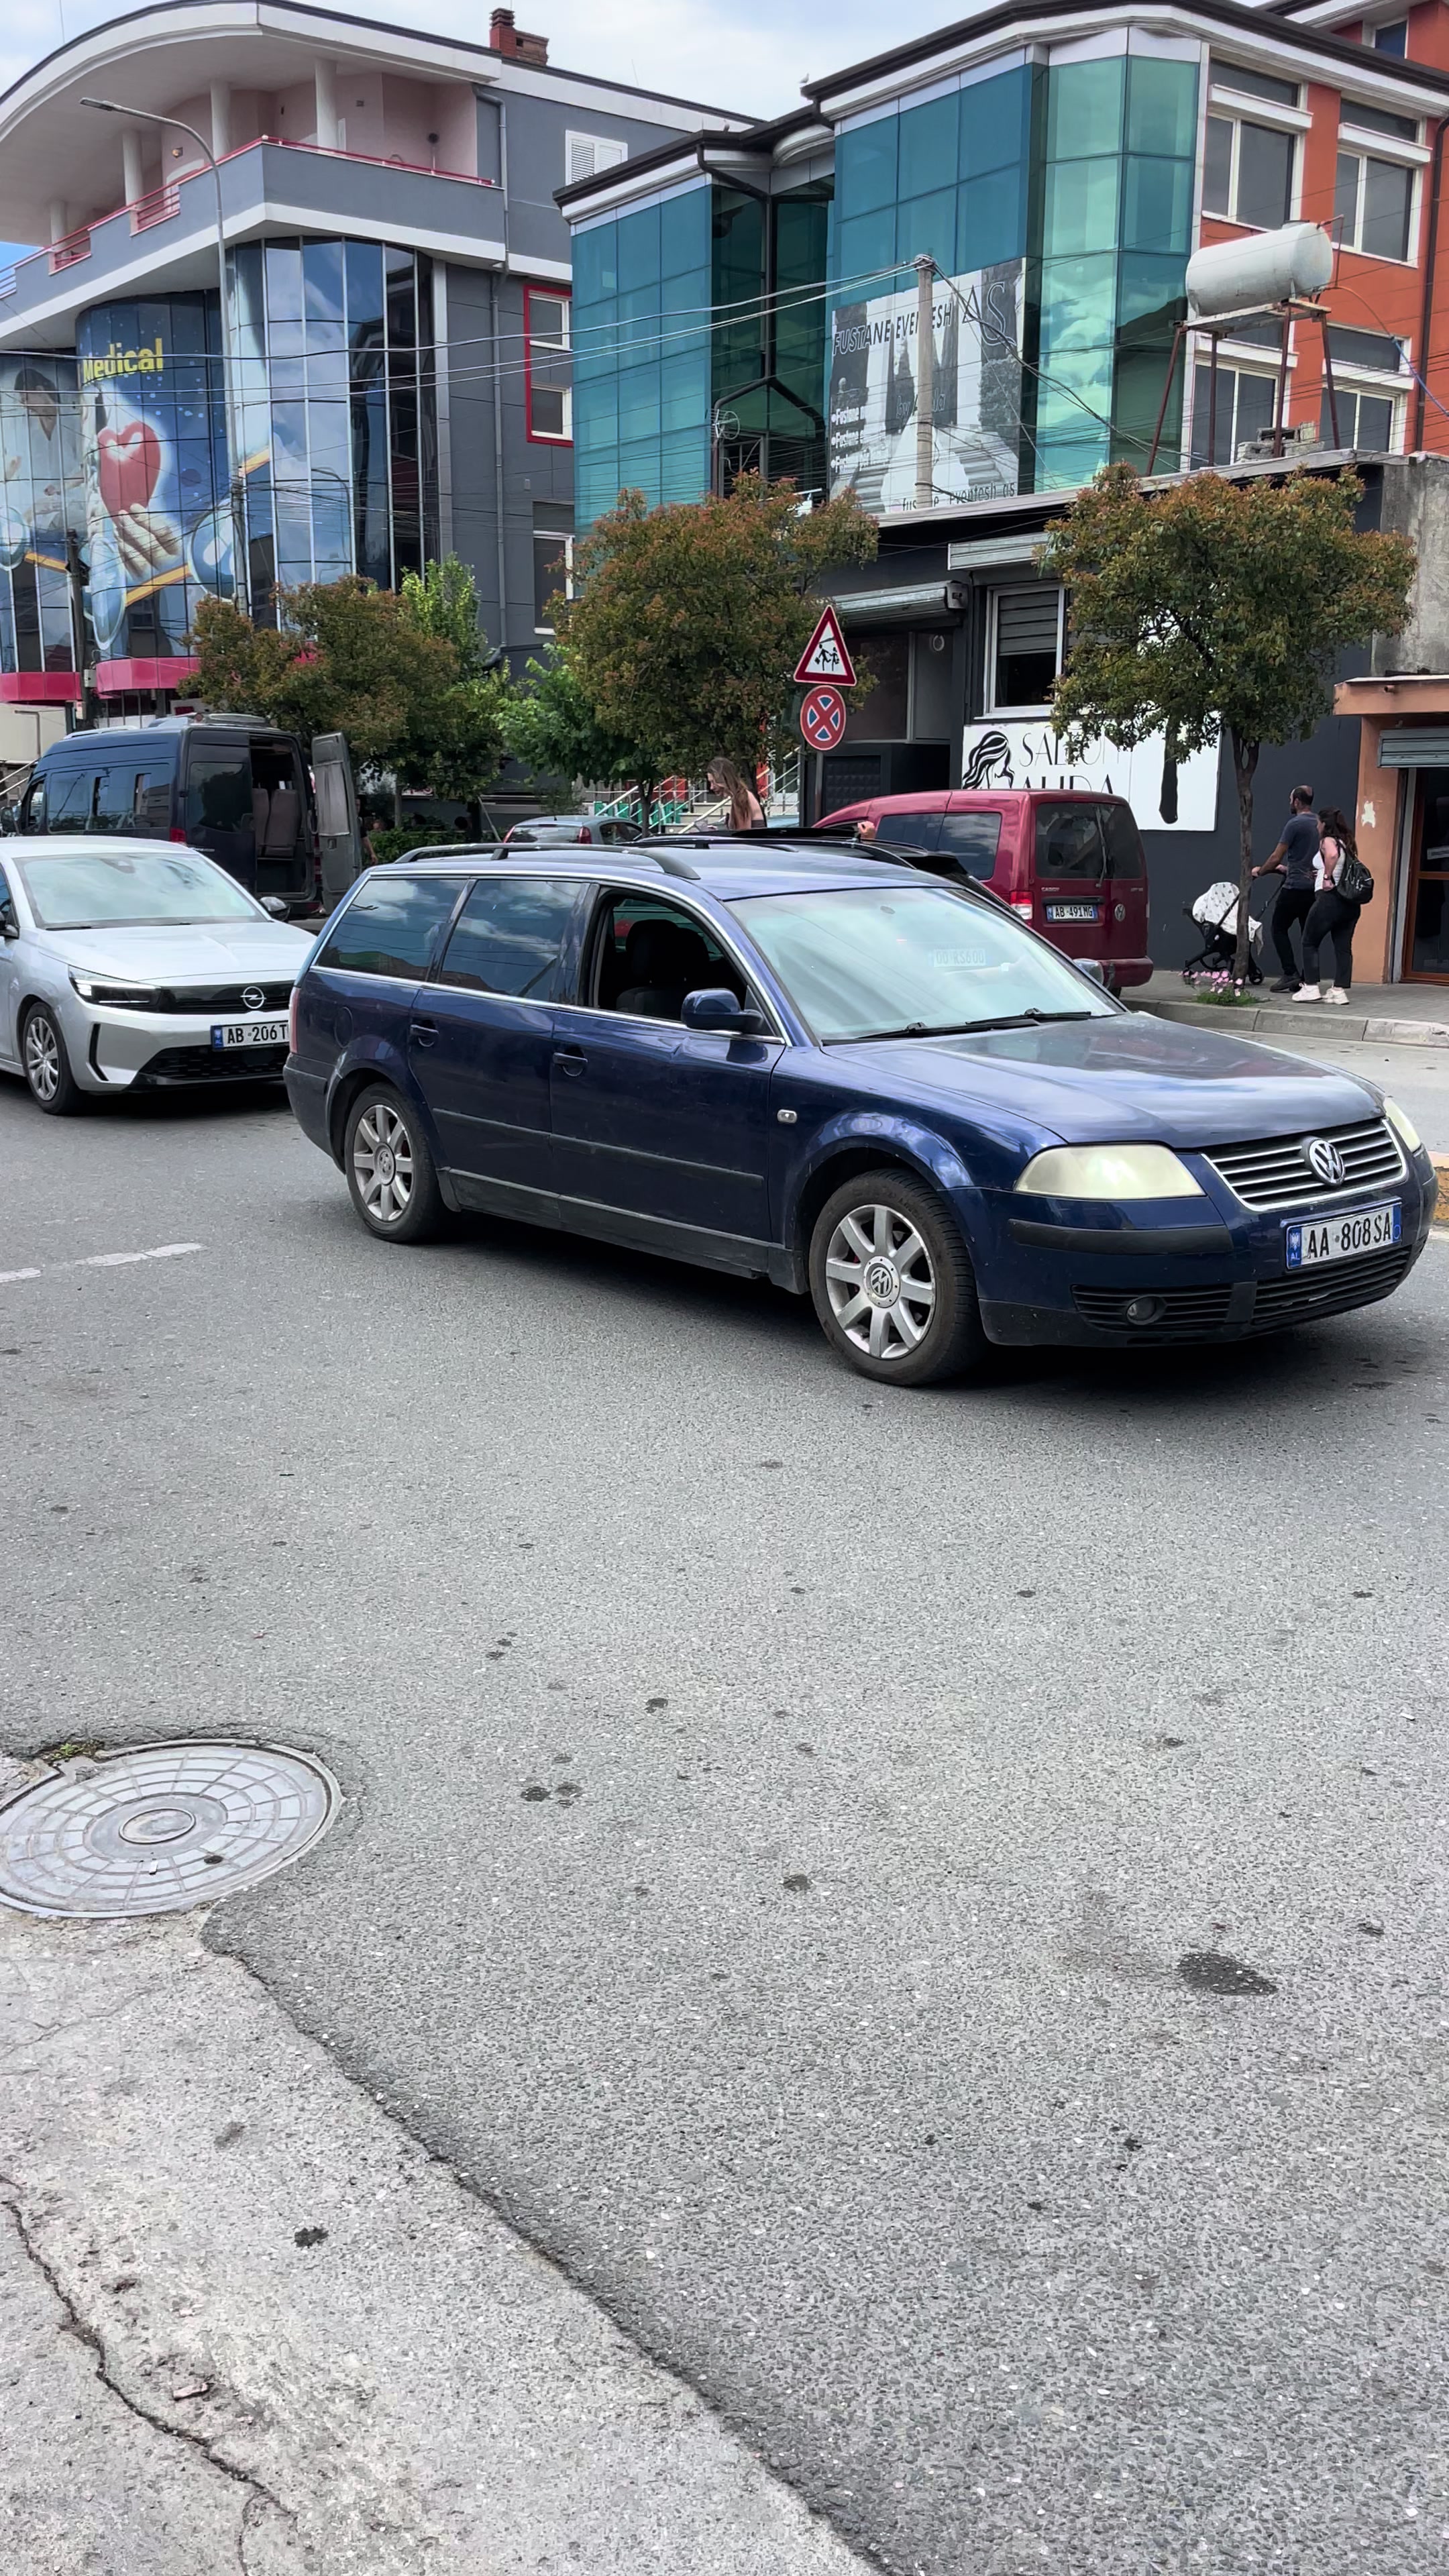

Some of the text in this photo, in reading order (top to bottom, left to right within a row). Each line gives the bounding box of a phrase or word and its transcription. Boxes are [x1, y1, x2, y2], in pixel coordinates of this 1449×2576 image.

[833, 303, 952, 356] FUSTANE EVEESH
[962, 282, 1017, 346] AS
[81, 337, 163, 387] Medical
[1018, 731, 1119, 768] SALON
[228, 1028, 244, 1044] AB
[1308, 1227, 1330, 1258] AA
